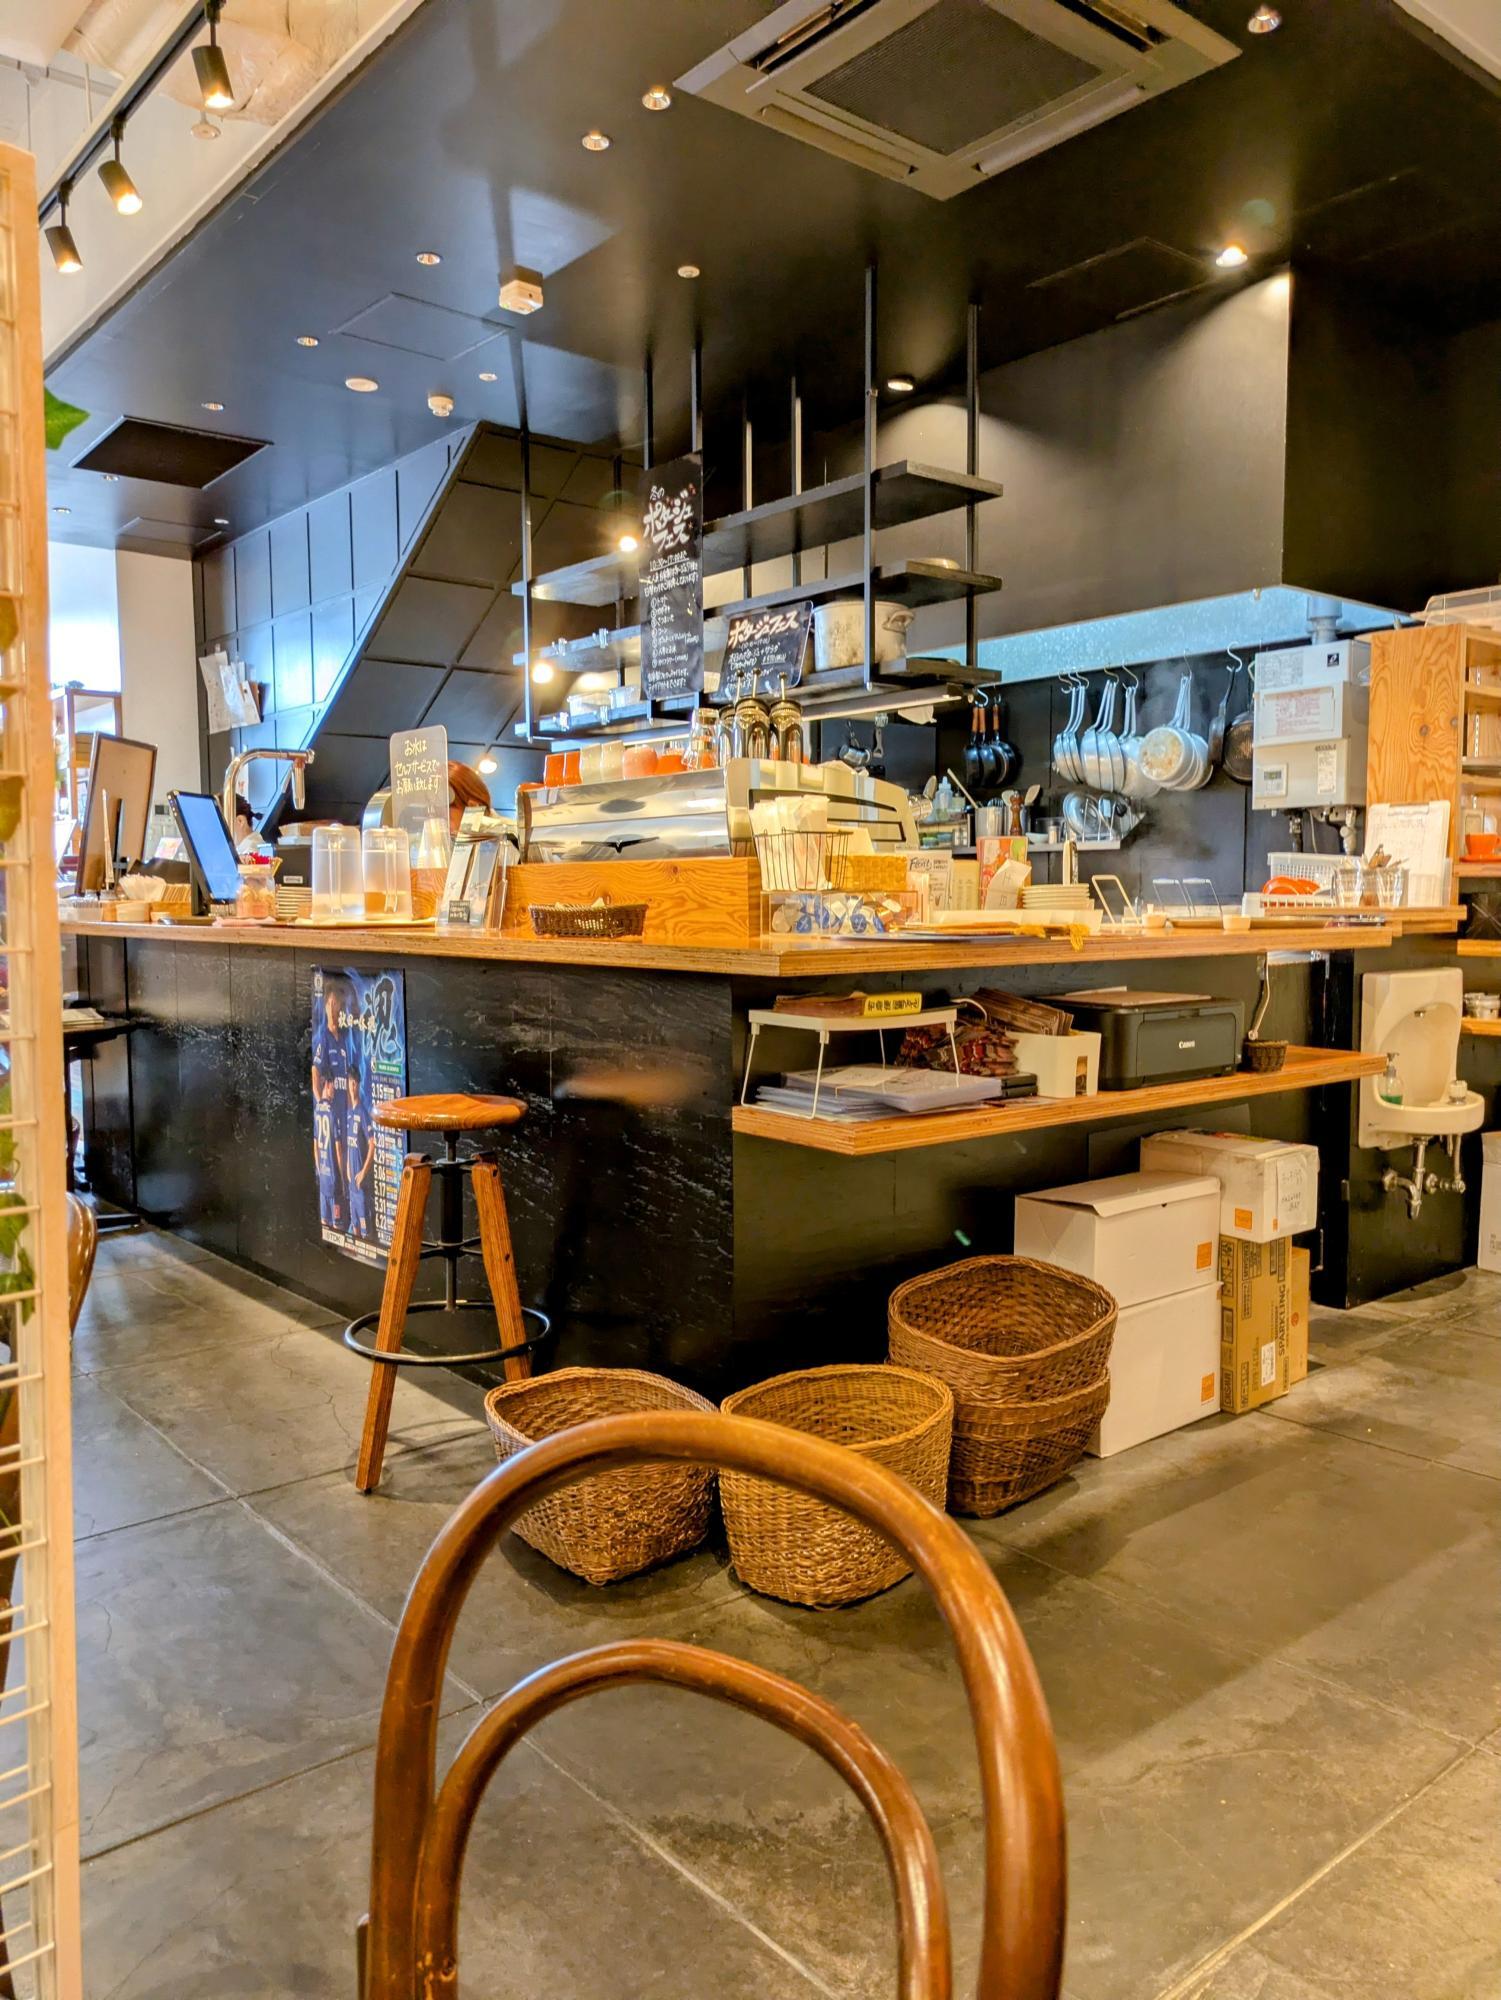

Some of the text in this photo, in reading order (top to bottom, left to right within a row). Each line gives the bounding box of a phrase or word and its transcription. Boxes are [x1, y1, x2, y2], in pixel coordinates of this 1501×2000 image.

[643, 488, 694, 538] ポタージュ
[653, 522, 690, 552] フェス
[728, 610, 799, 649] ポタージュフェス
[404, 737, 428, 757] お水は
[394, 759, 440, 777] セルフサービスで
[396, 774, 442, 796] お願い致します
[371, 1082, 384, 1099] 3.15
[373, 1163, 386, 1181] 5.06
[374, 1180, 387, 1198] 5.17
[374, 1196, 387, 1215] 5.31
[1278, 1284, 1287, 1357] SPARKLING
